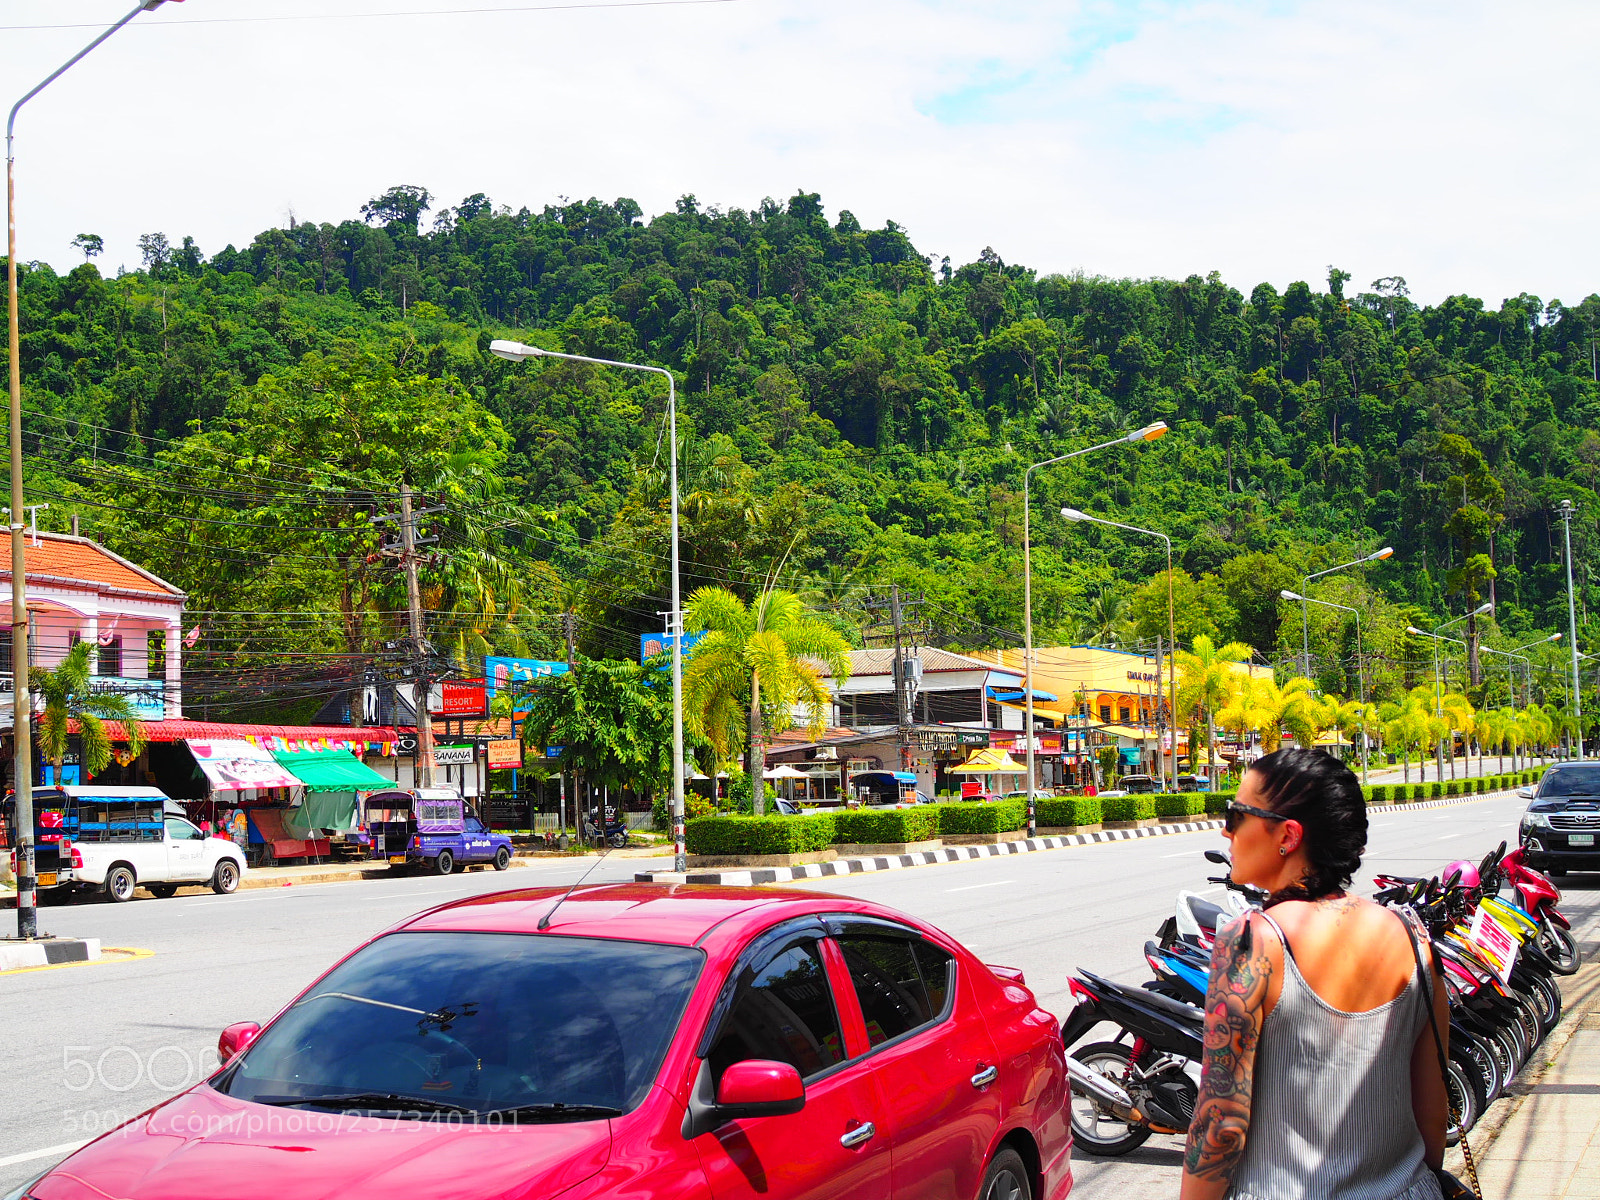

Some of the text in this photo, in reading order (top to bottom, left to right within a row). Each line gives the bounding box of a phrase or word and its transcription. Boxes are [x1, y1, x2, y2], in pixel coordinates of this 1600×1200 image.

[445, 697, 474, 706] RESORT
[489, 741, 518, 750] KHAOLAK
[434, 751, 471, 761] BANANA
